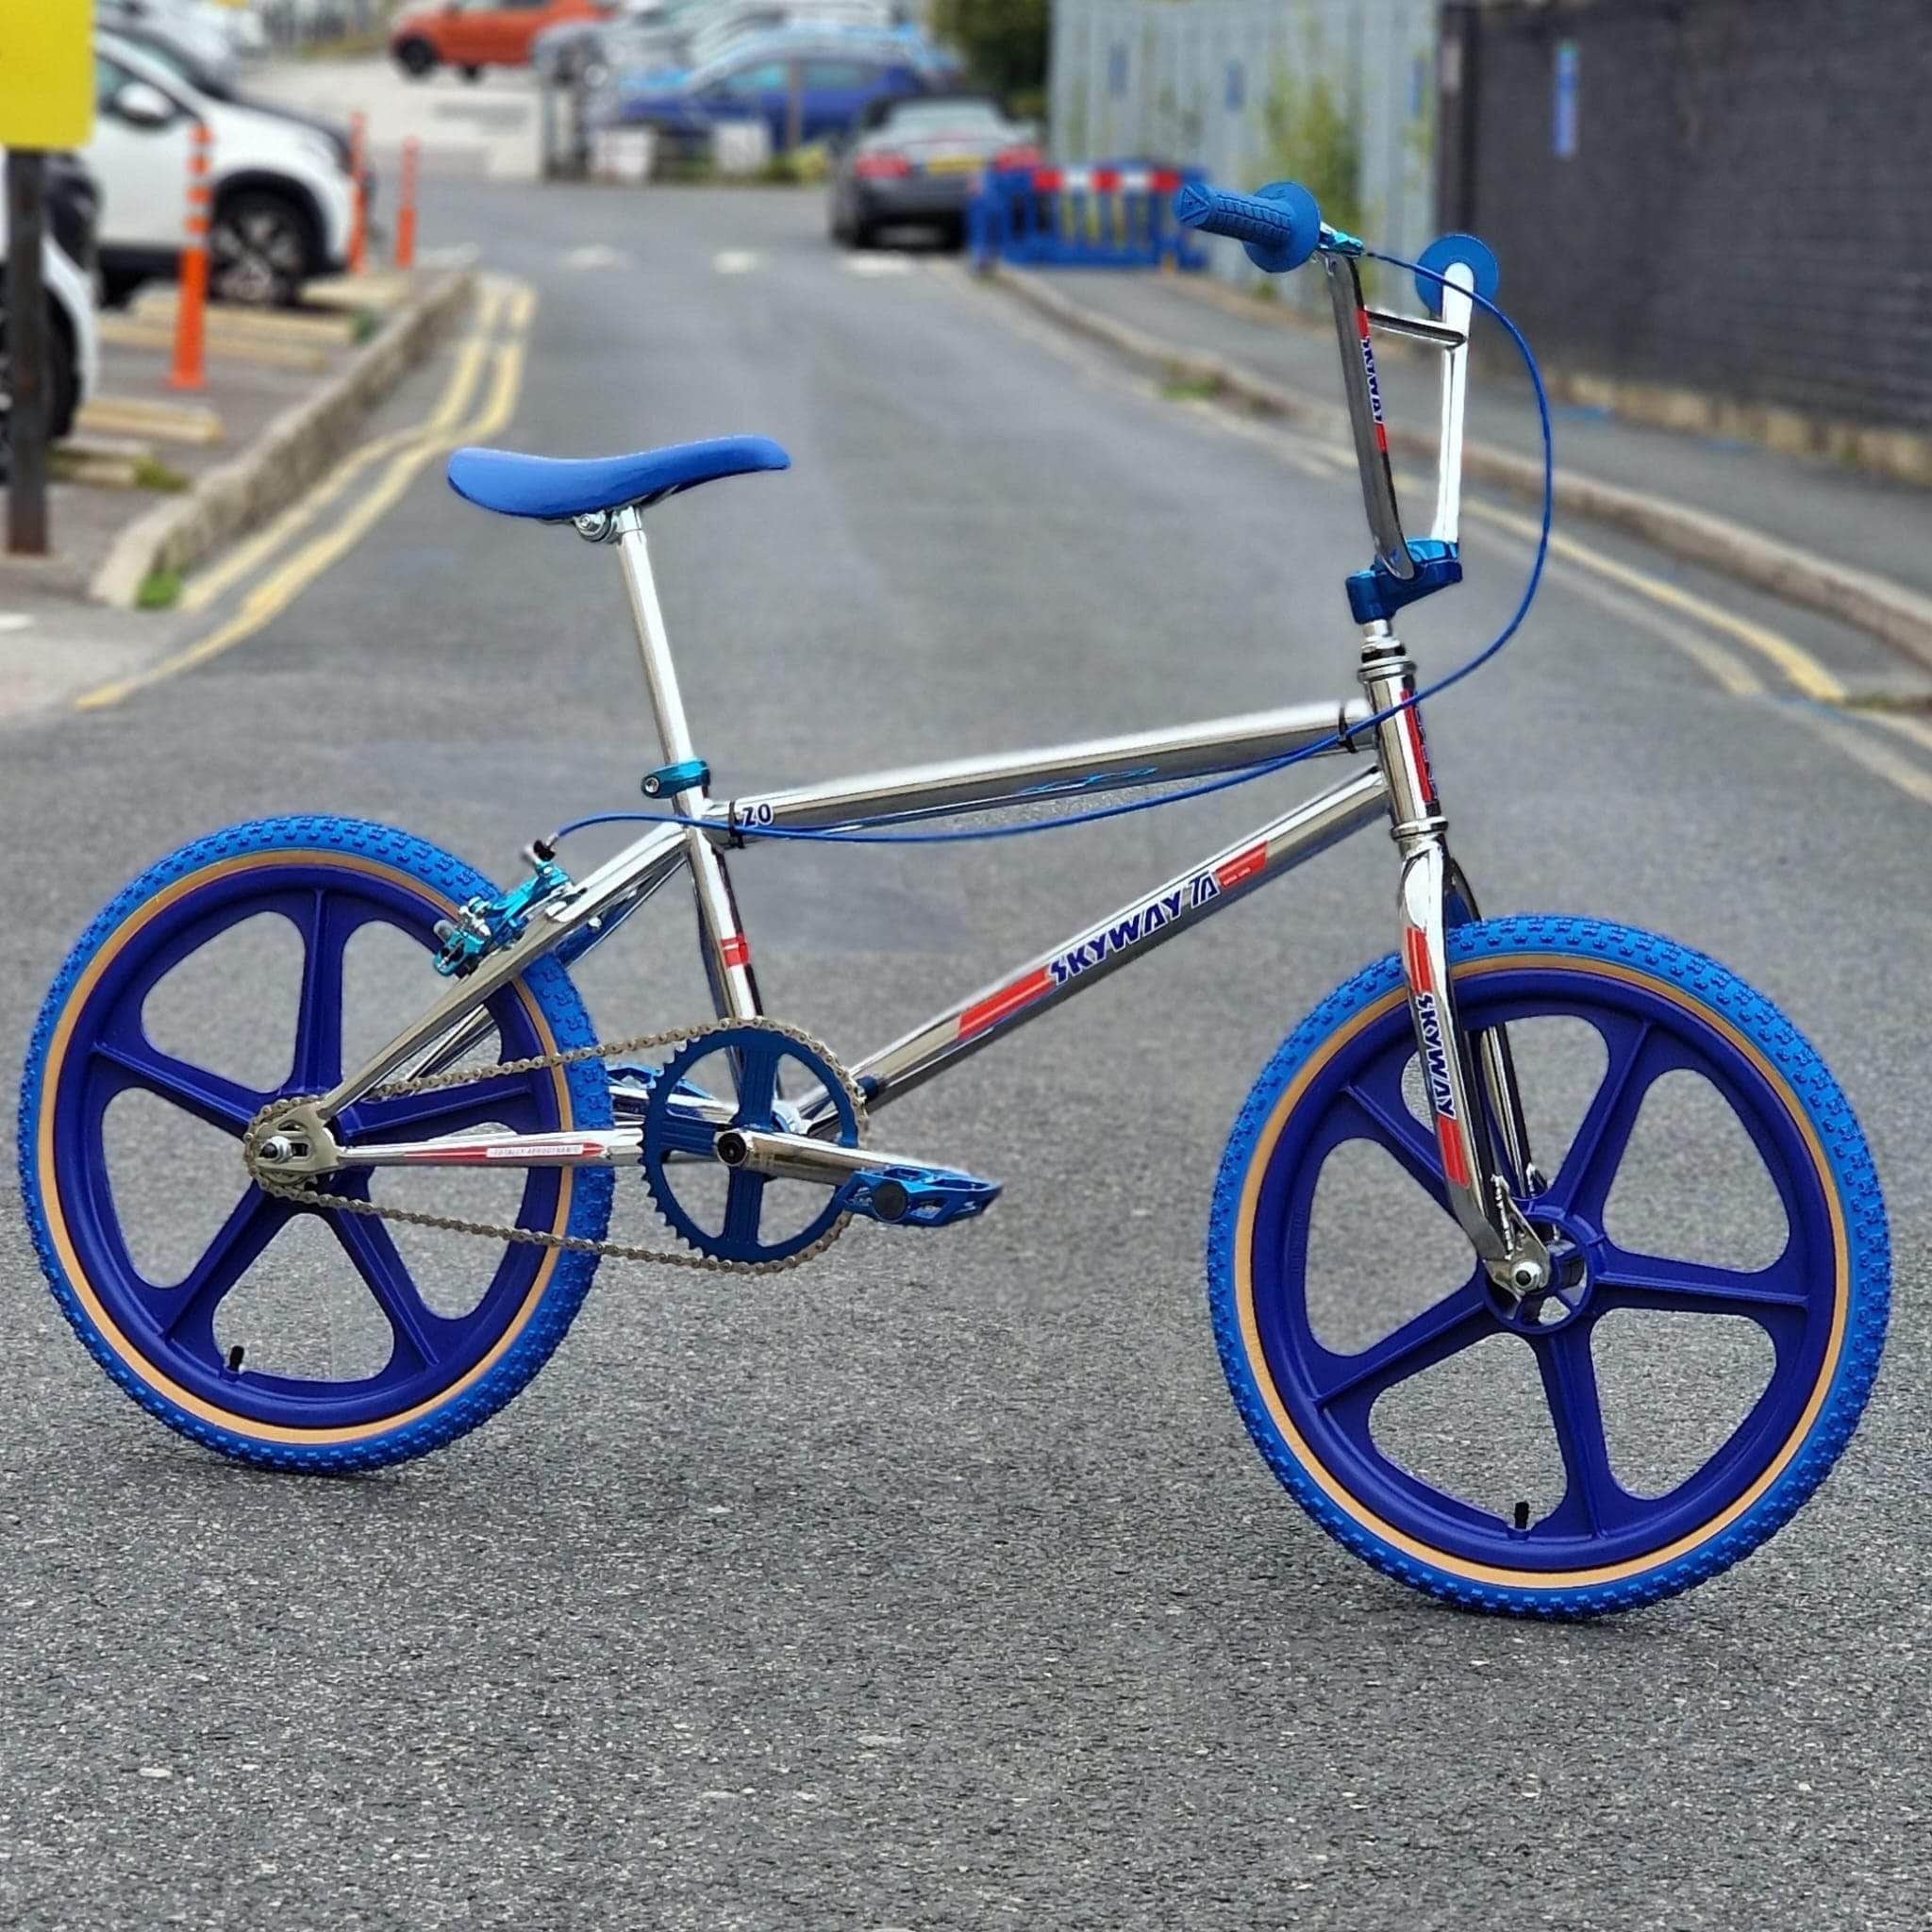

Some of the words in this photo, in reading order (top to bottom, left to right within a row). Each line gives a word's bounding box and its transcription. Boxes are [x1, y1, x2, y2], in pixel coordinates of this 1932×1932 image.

[1049, 890, 1184, 985] SKYWAY
[1187, 871, 1220, 908] TA
[1417, 992, 1457, 1120] SKYWAY
